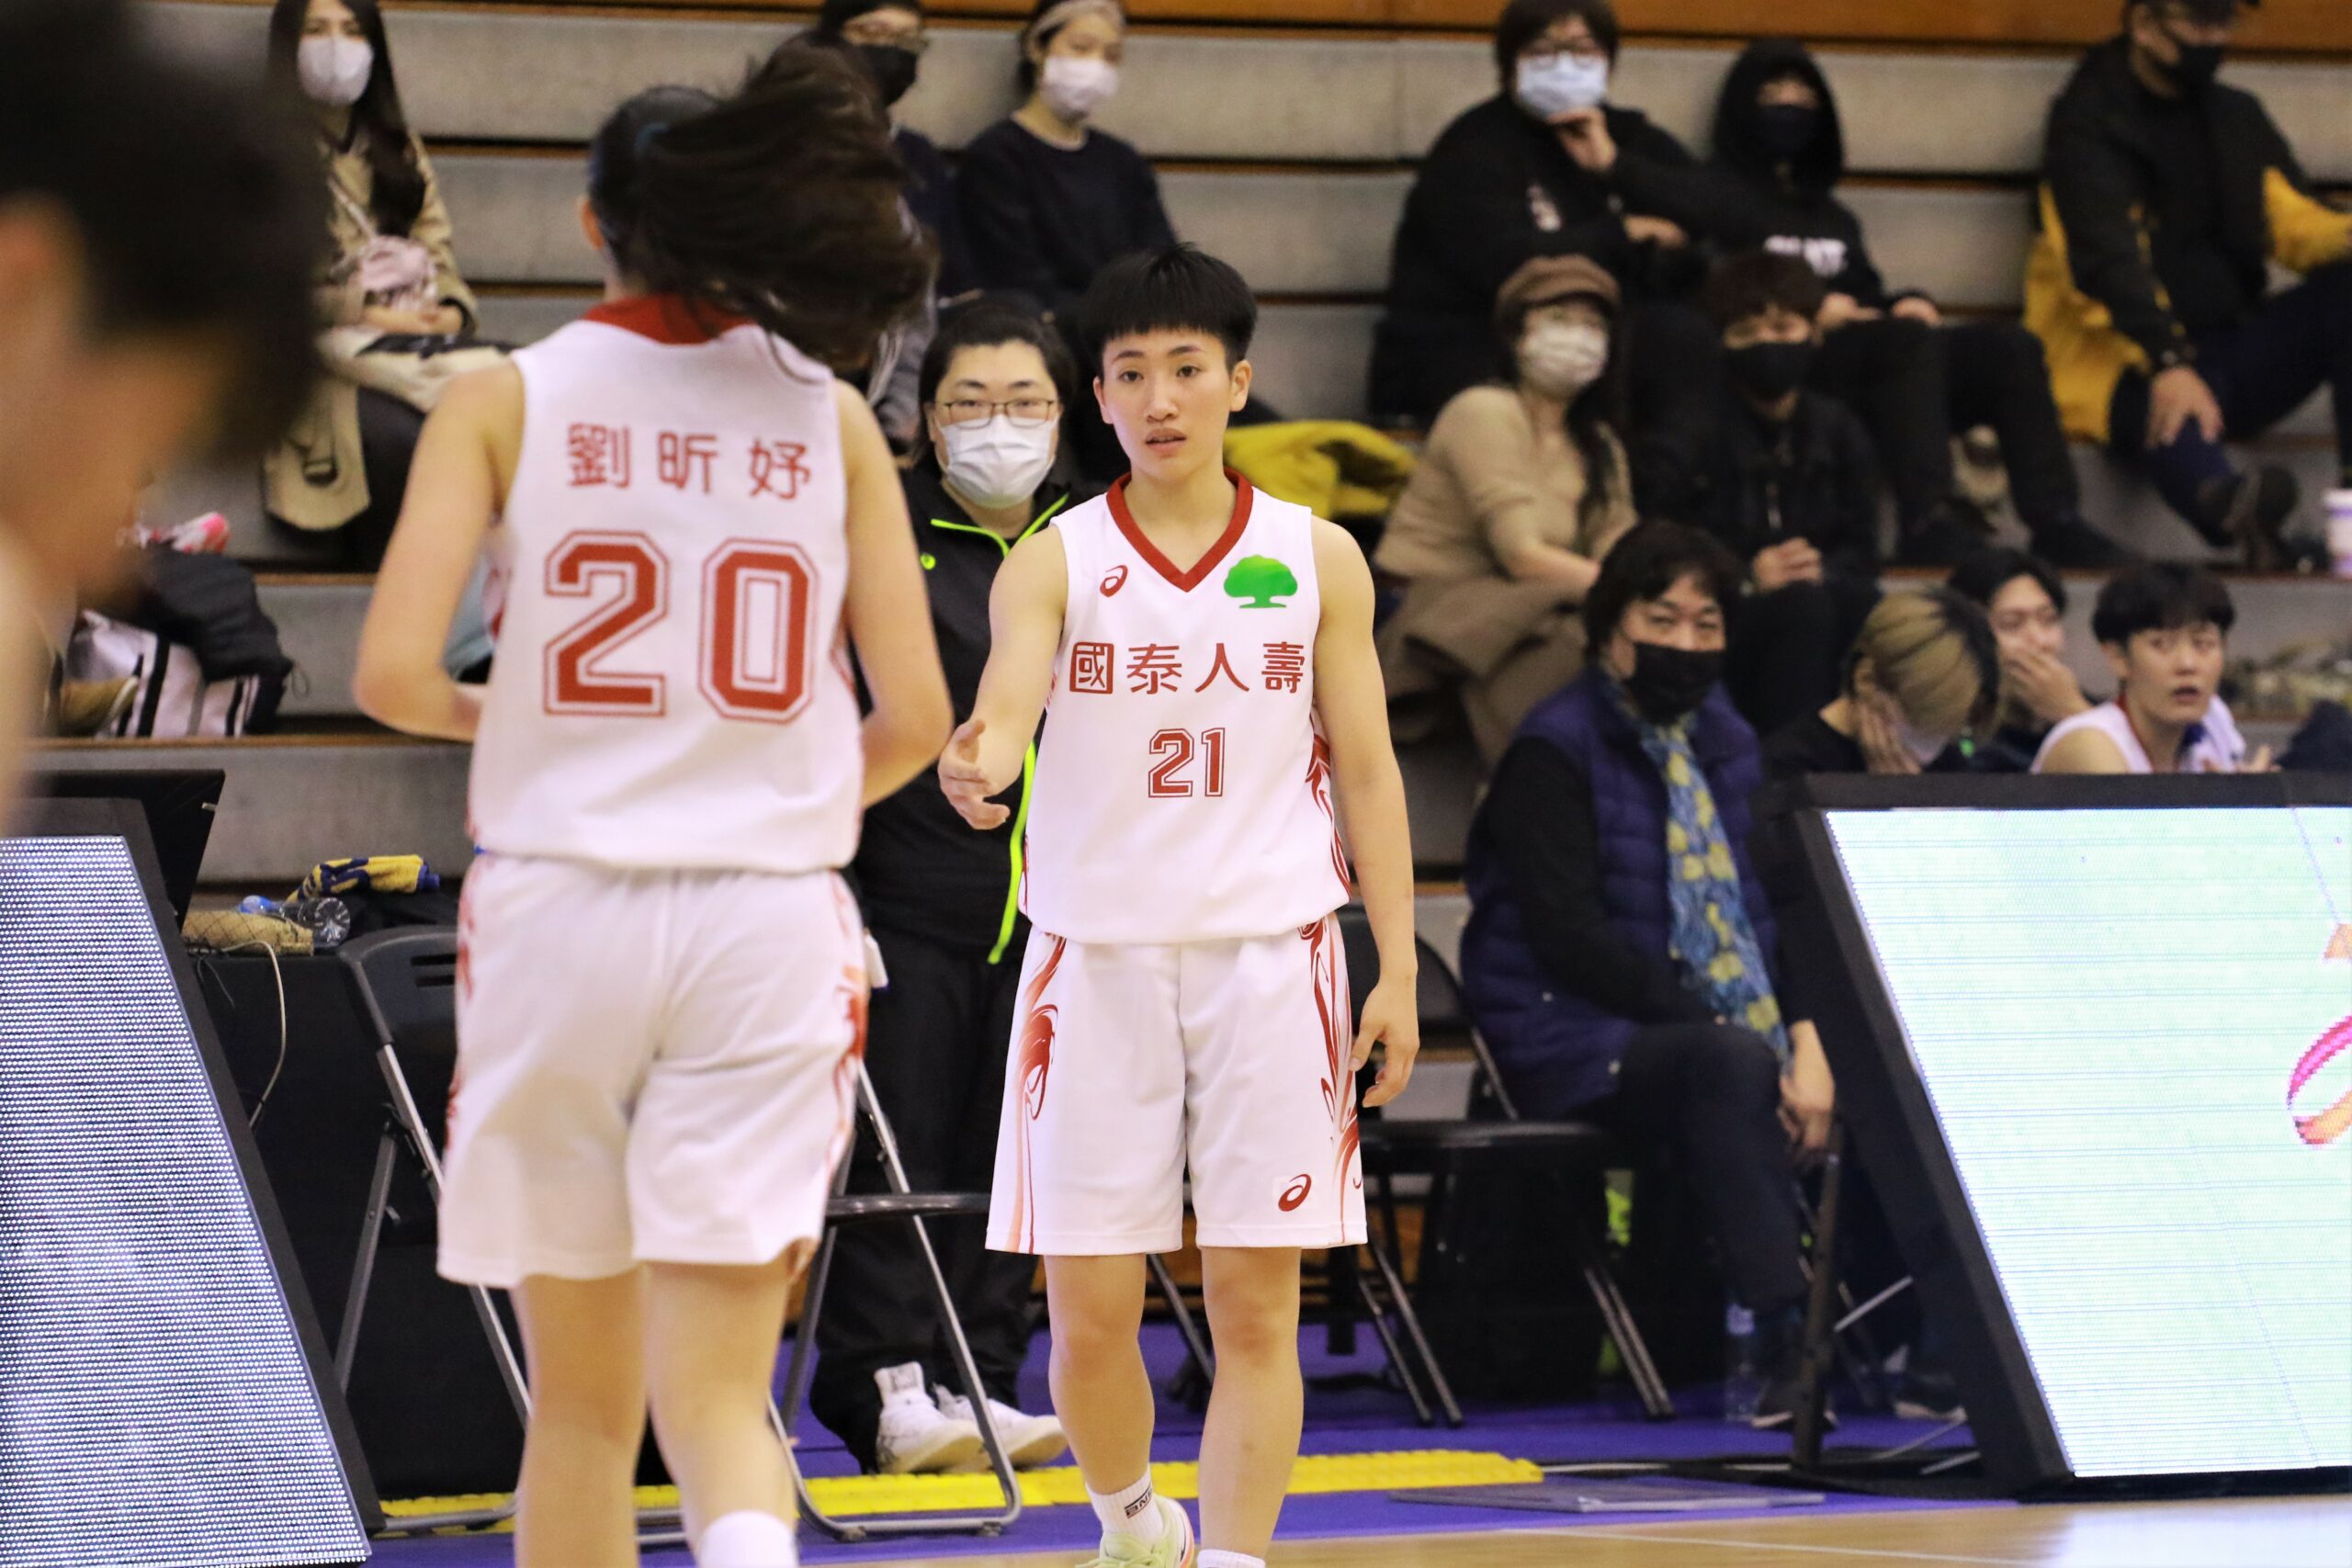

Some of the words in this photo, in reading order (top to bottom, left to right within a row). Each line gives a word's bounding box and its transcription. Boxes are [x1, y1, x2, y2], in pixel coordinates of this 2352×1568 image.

[567, 423, 811, 501] 劉昕妤
[544, 529, 819, 727] 20
[1069, 641, 1306, 694] 國泰人壽
[1148, 727, 1226, 798] 21
